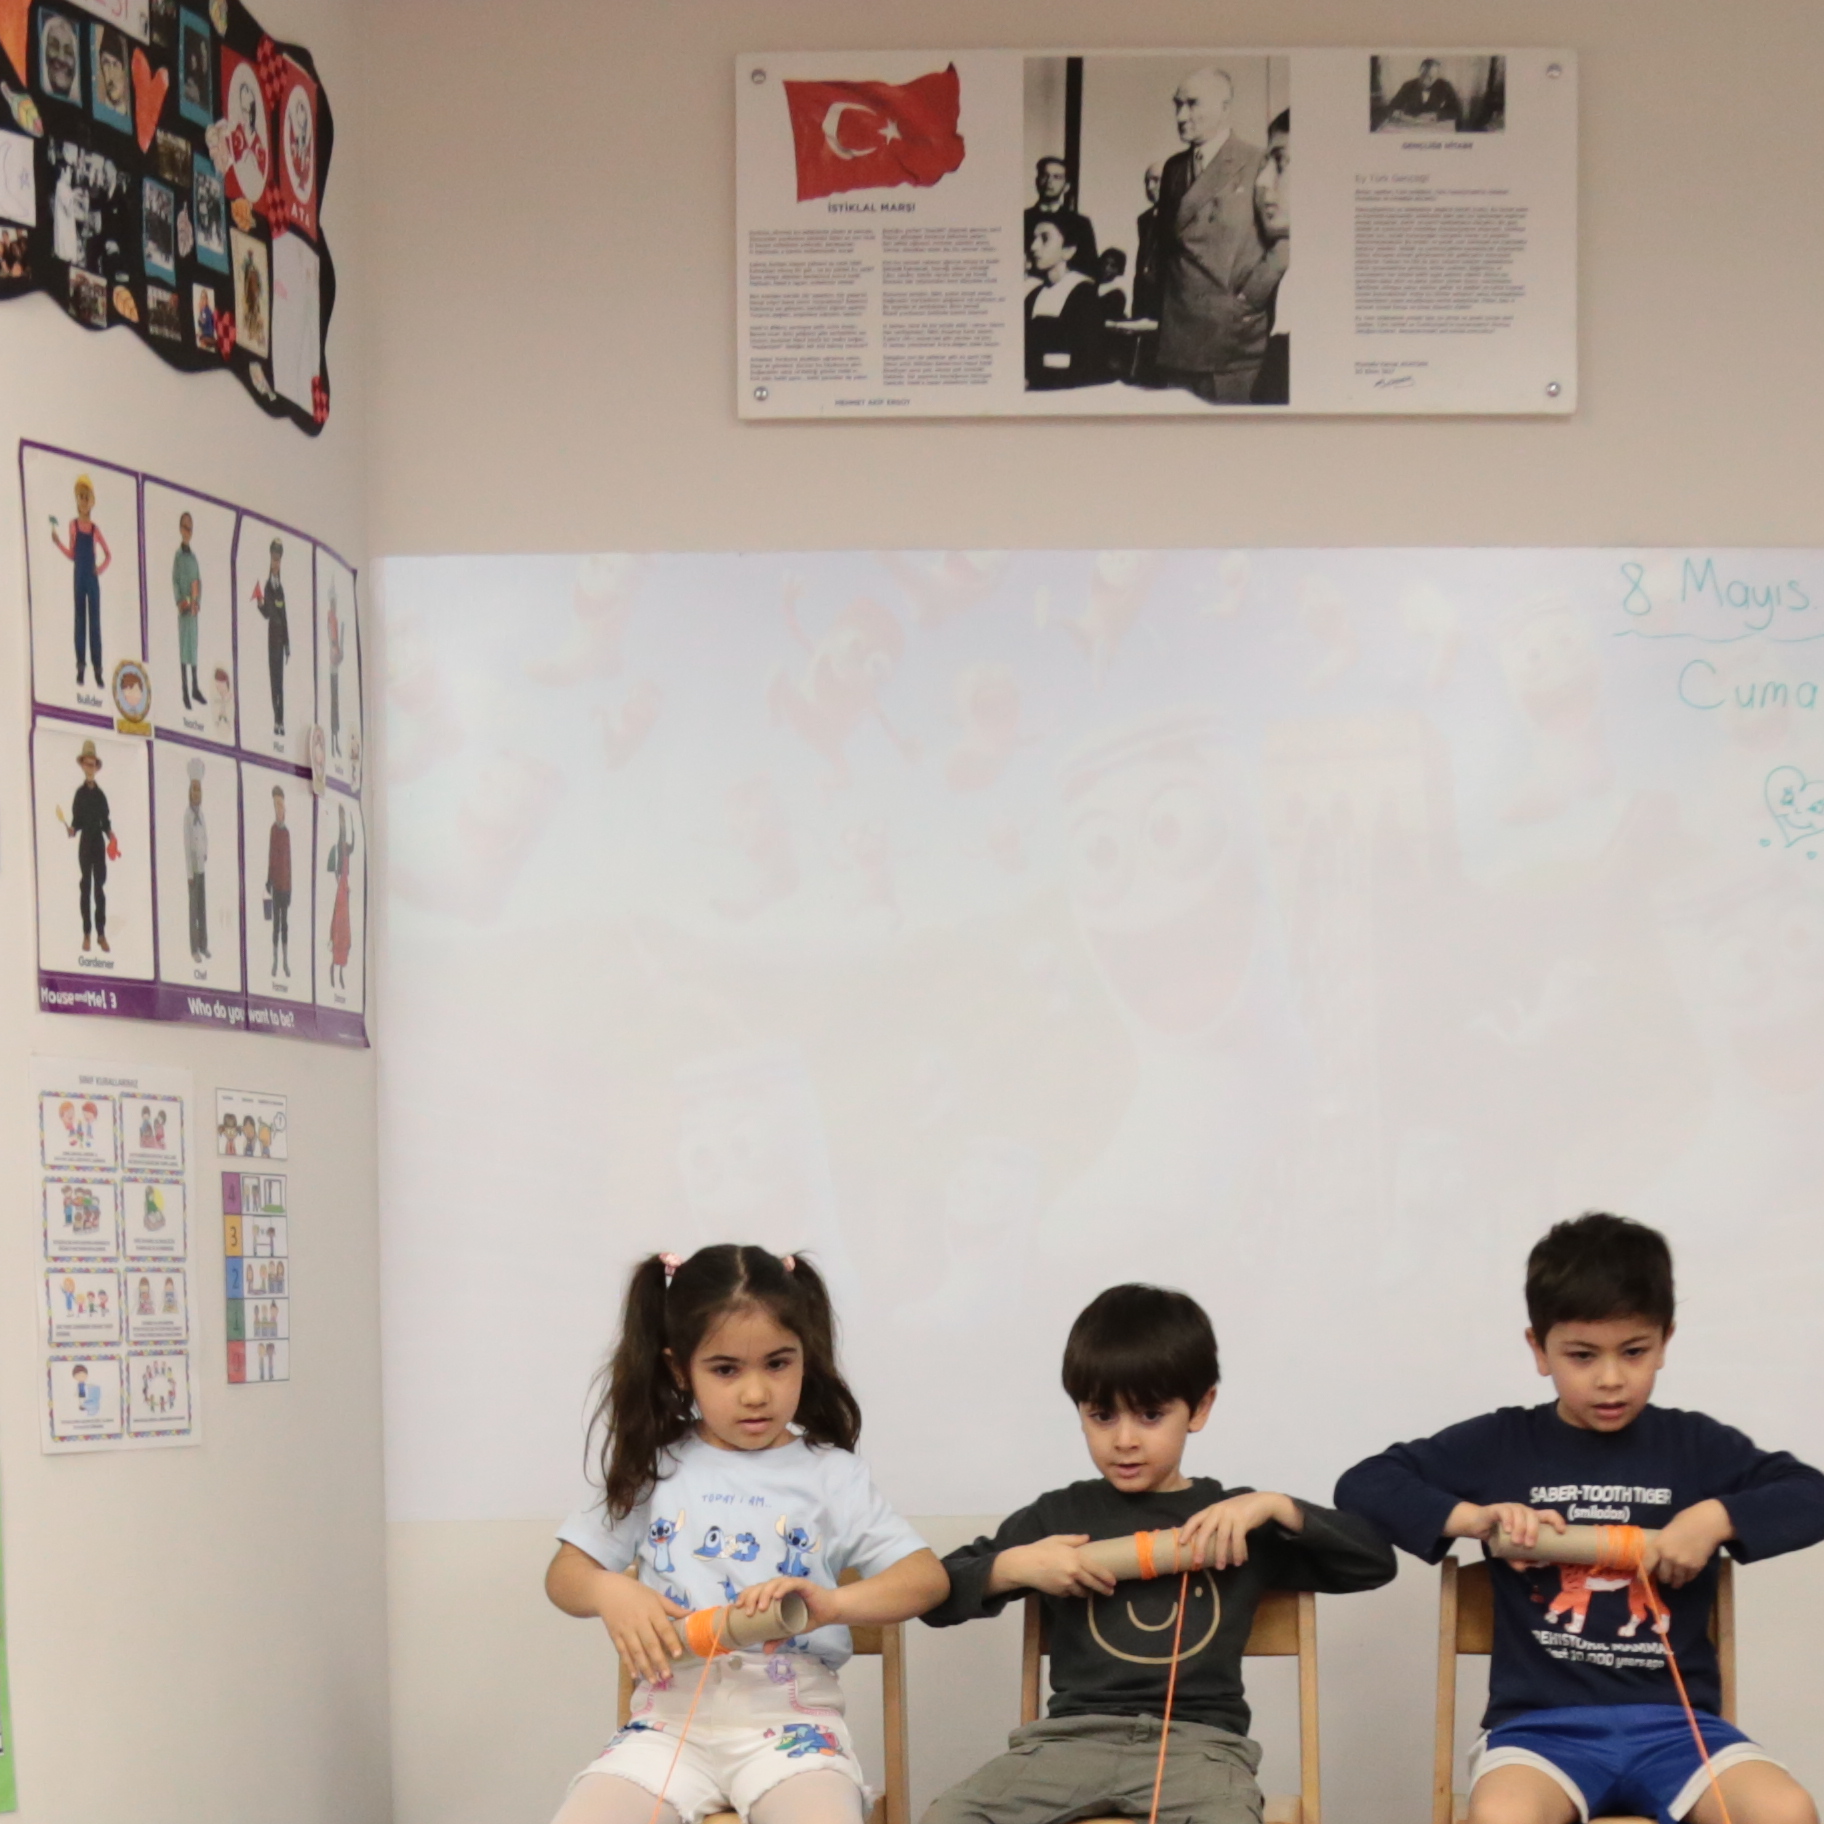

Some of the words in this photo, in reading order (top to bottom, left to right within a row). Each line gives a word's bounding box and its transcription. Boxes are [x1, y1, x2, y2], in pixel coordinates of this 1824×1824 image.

[290, 203, 311, 228] ATA
[1620, 561, 1652, 616] 8
[1678, 658, 1819, 710] Cuma
[76, 693, 104, 708] Builder
[78, 956, 115, 970] Gardener
[41, 986, 74, 1005] Mouse
[110, 991, 117, 1009] 3
[187, 997, 212, 1016] Who
[214, 1001, 226, 1018] do
[231, 1226, 238, 1247] 3
[232, 1268, 240, 1289] 2
[702, 1493, 735, 1505] TODAY
[1530, 1485, 1633, 1503] SABER-TOOTH
[1633, 1486, 1672, 1505] TIGER
[1567, 1504, 1630, 1523] (smilodon)
